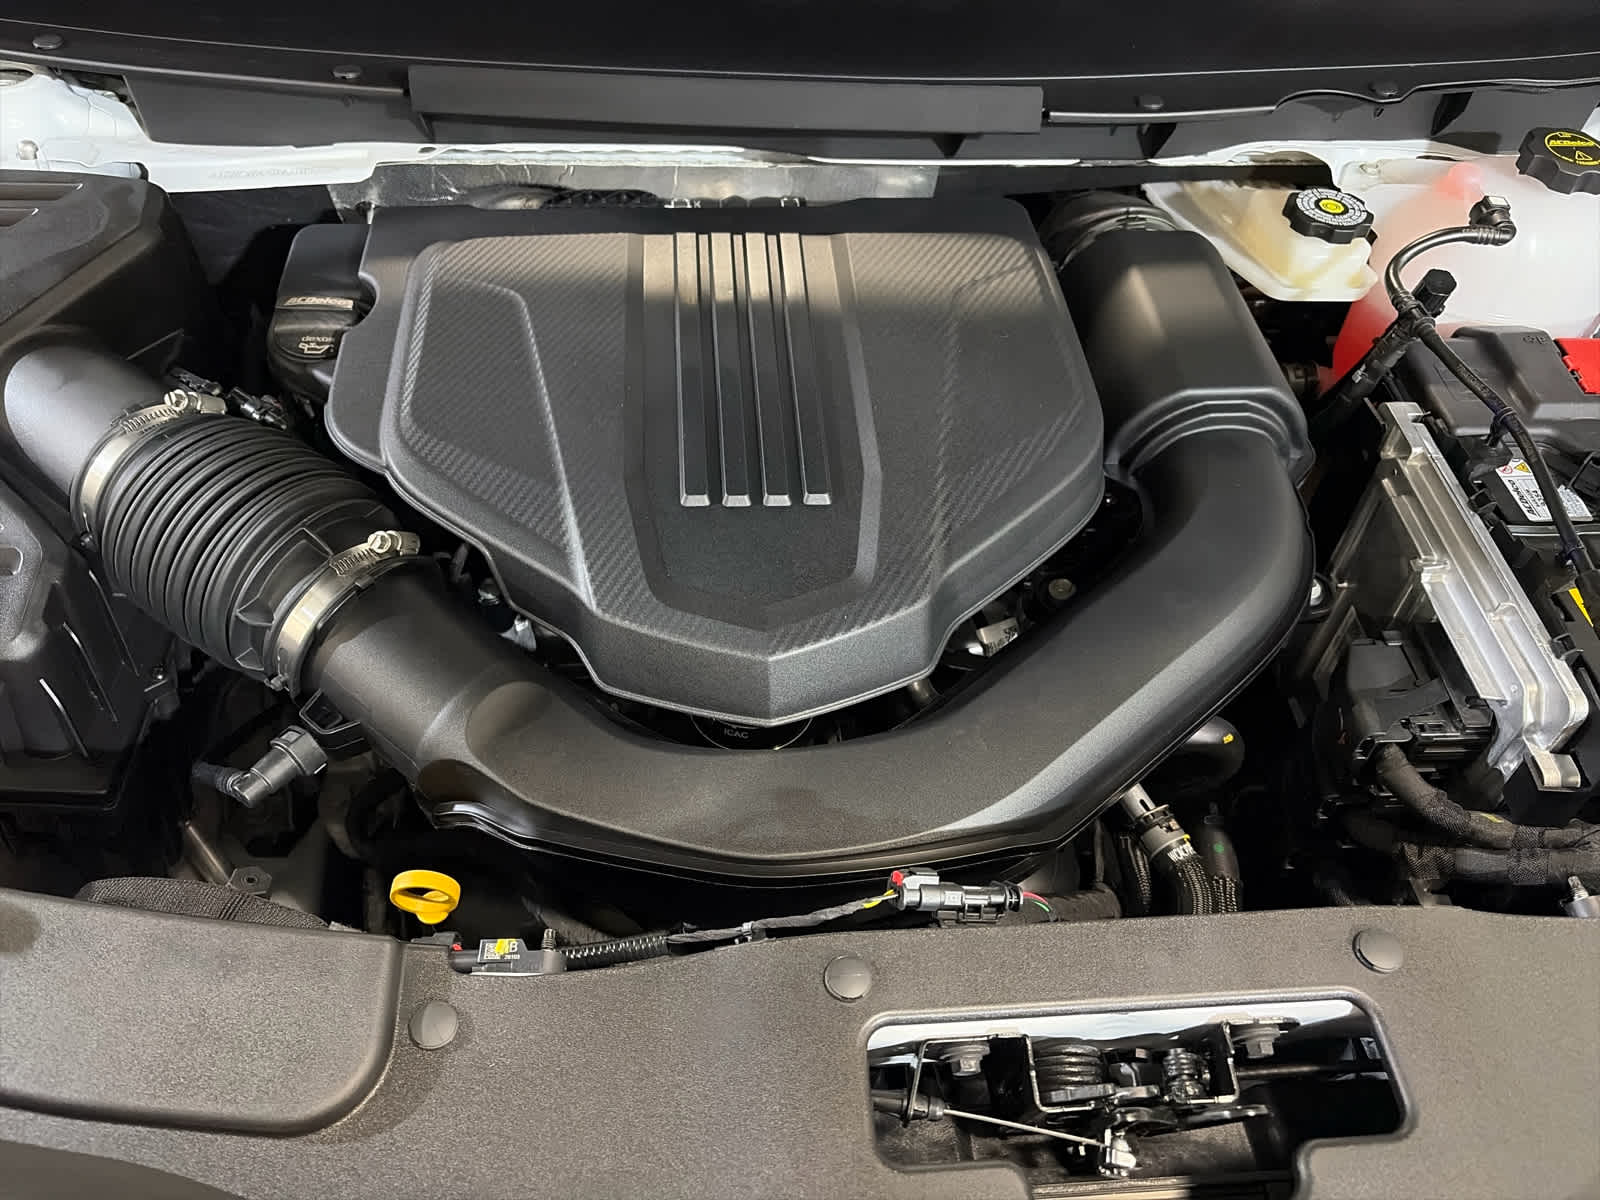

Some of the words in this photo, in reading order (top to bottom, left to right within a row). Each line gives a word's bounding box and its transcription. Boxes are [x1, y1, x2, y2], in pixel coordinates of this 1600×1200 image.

[284, 297, 348, 308] ACDelco
[1507, 479, 1537, 516] ACDelco
[724, 728, 749, 739] ICAC
[509, 941, 518, 952] B
